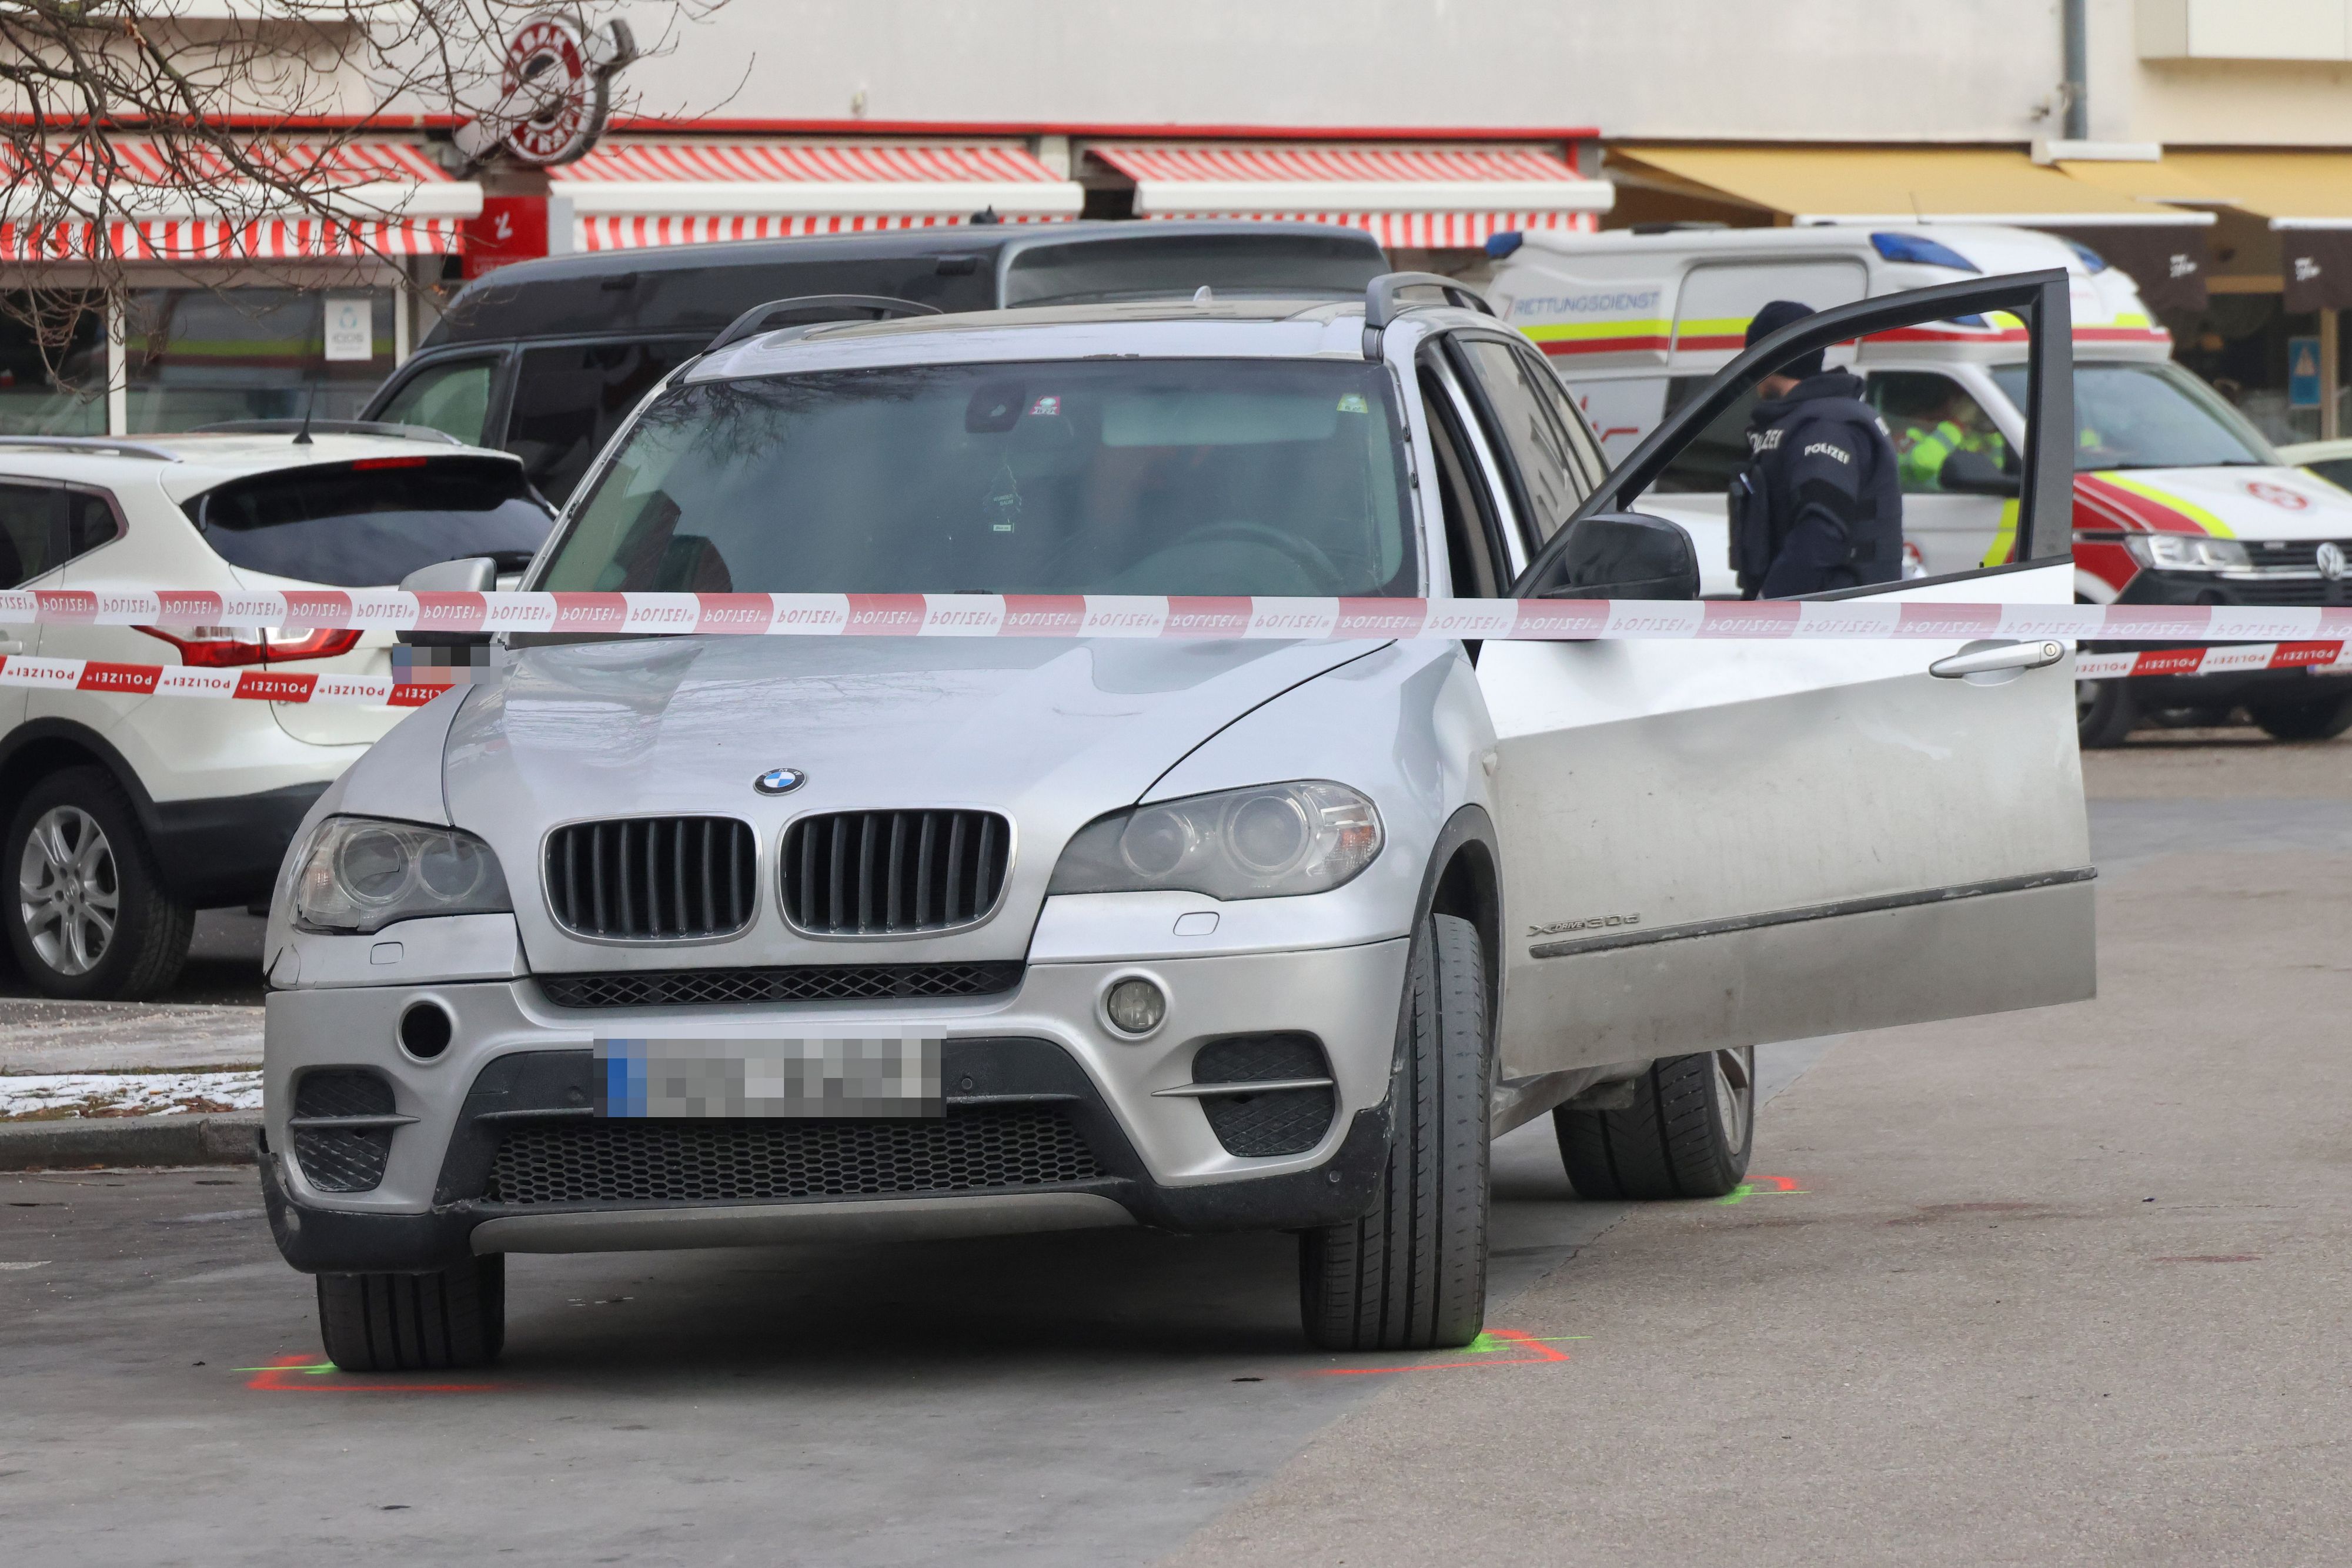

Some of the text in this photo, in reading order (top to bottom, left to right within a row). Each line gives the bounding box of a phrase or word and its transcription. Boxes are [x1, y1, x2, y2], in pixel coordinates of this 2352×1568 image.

[1514, 292, 1661, 315] RETTUNGSDIENST
[1805, 442, 1850, 464] POLIZEI
[2283, 650, 2334, 660] POLIZEI
[2146, 658, 2197, 670] POLIZEI
[17, 667, 75, 680] POLIZEI
[96, 672, 152, 686] POLIZEI
[173, 677, 230, 689] POLIZEI
[252, 681, 308, 694] POLIZEI
[329, 685, 385, 696] POLIZEI
